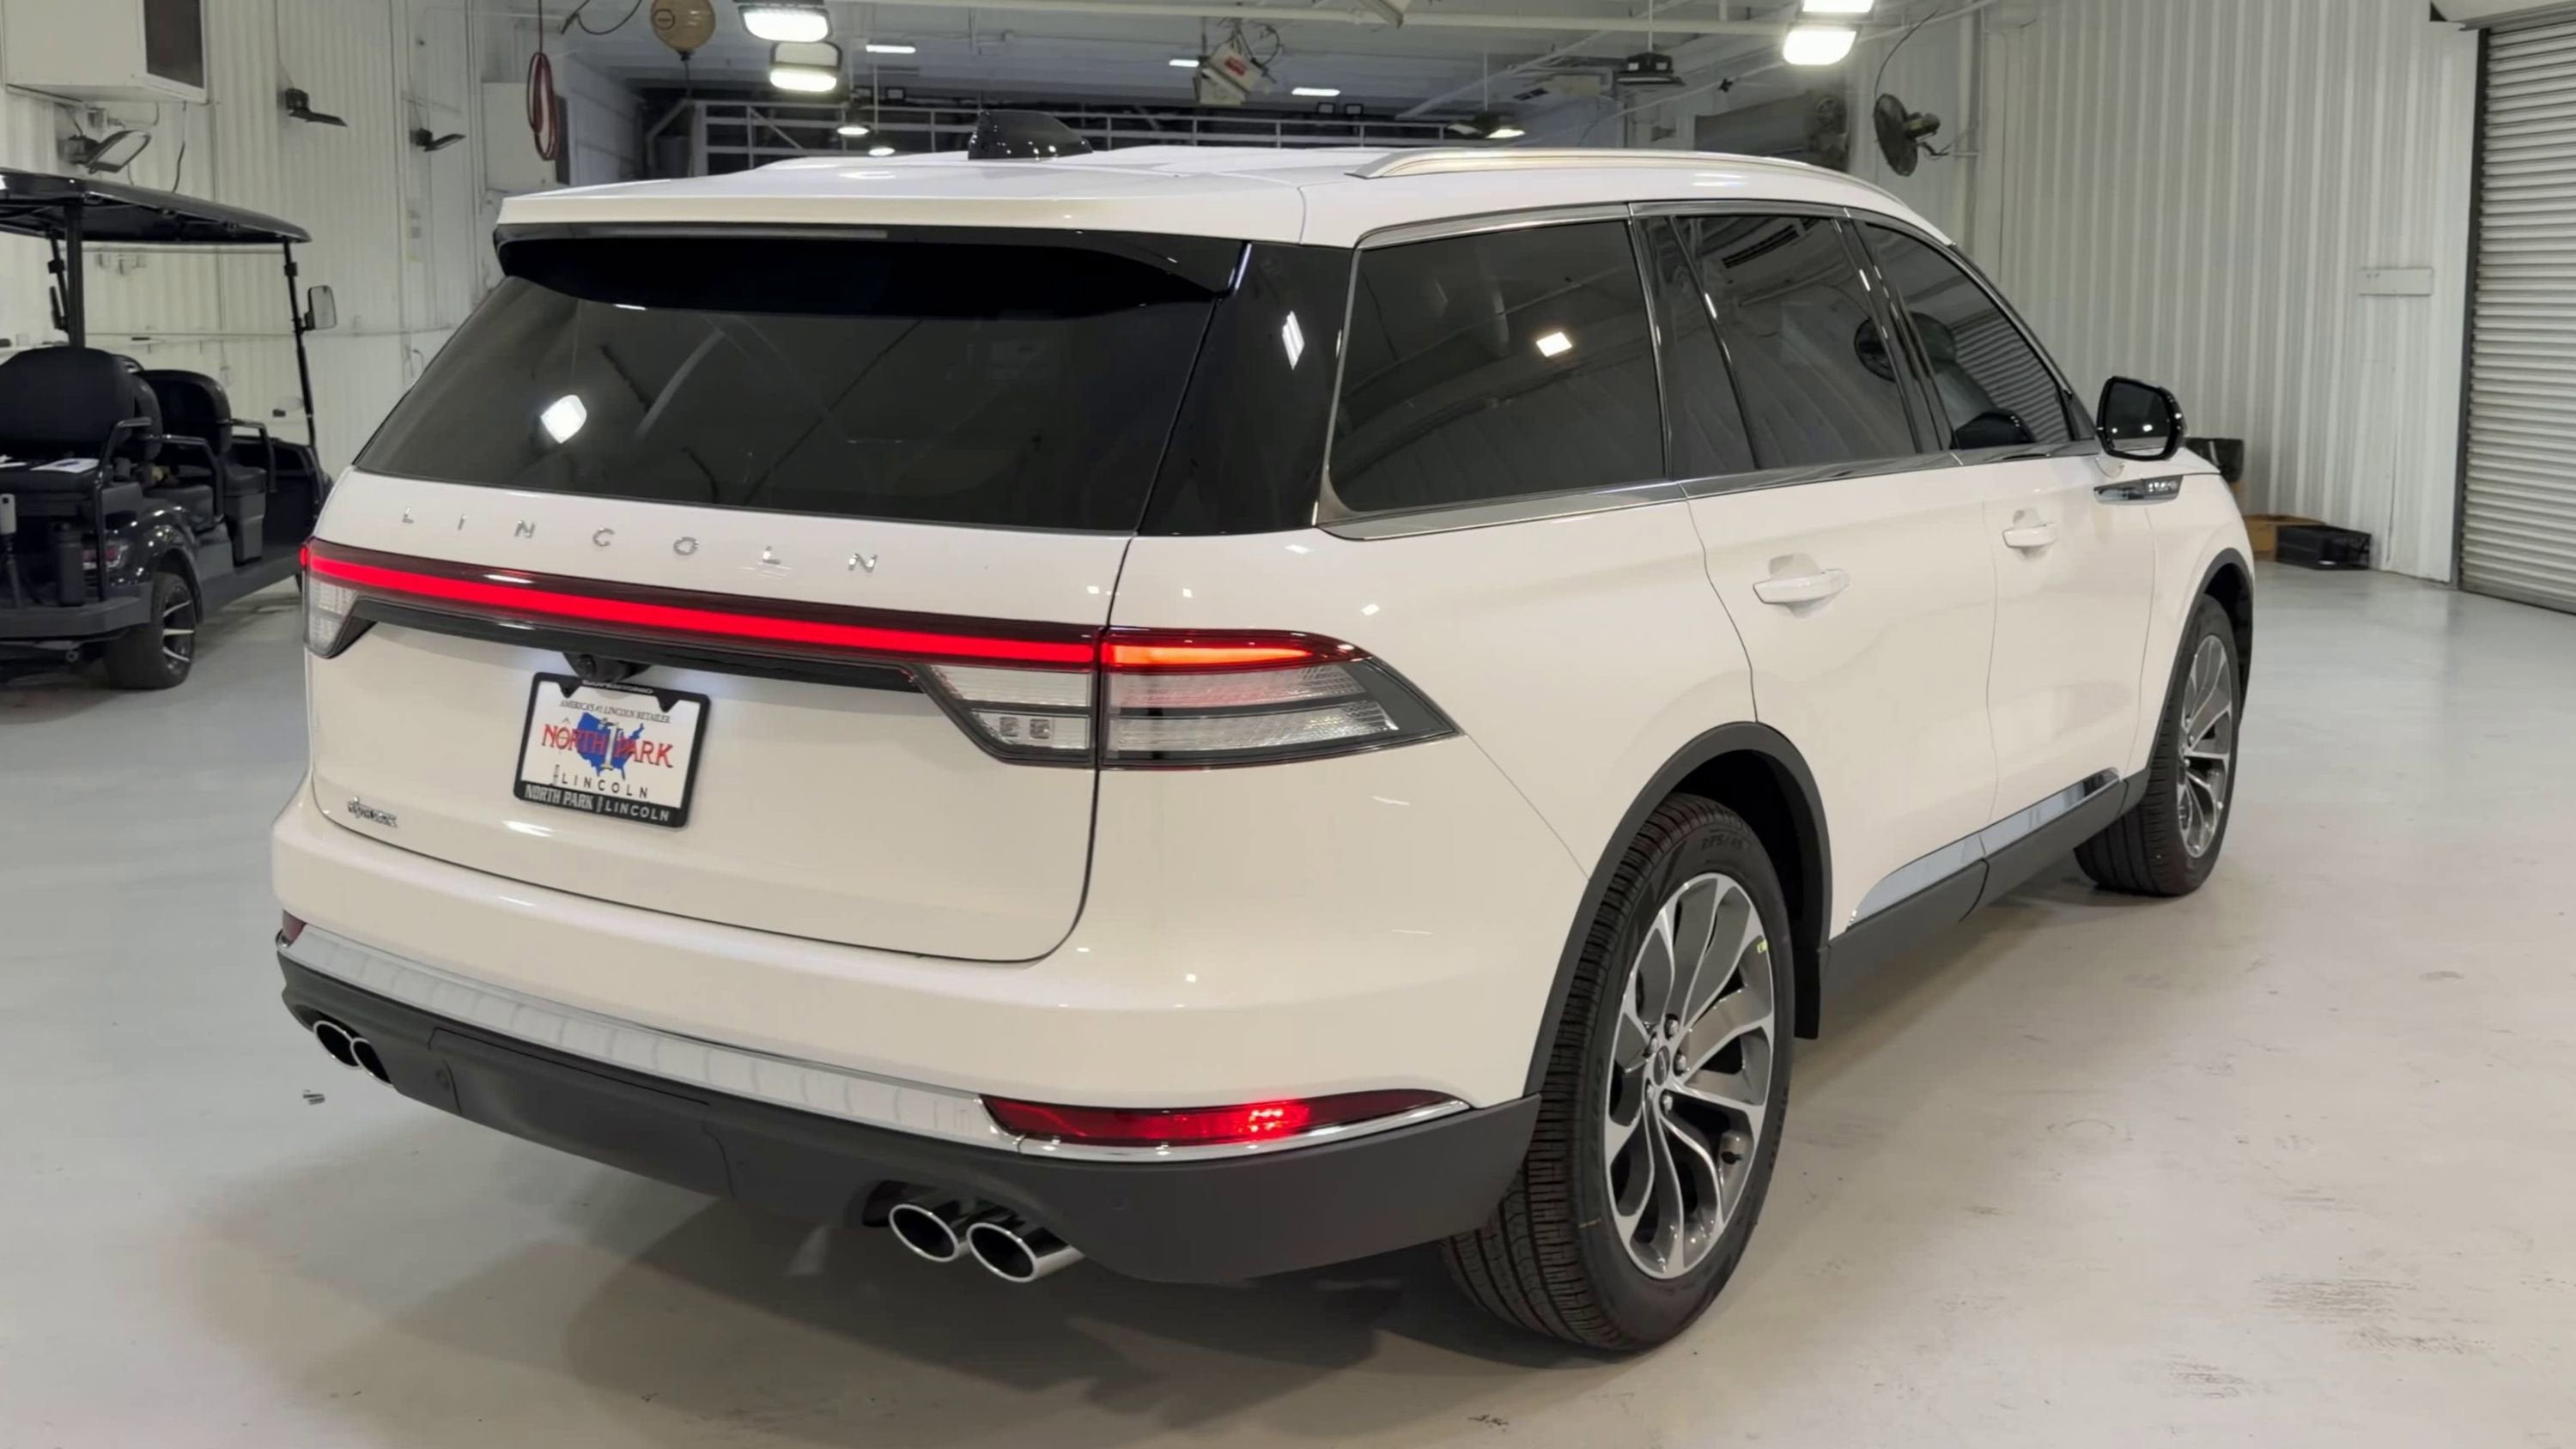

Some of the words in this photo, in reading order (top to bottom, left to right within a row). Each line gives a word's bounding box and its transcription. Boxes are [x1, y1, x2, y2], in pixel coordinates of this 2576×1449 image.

[401, 506, 878, 573] LINCOLN
[541, 723, 606, 756] NORTH
[615, 736, 674, 768] PARK
[524, 783, 562, 805] NORTH
[562, 790, 594, 810] PARK
[605, 799, 670, 822] LINCOLN
[562, 773, 648, 798] LINCOLN
